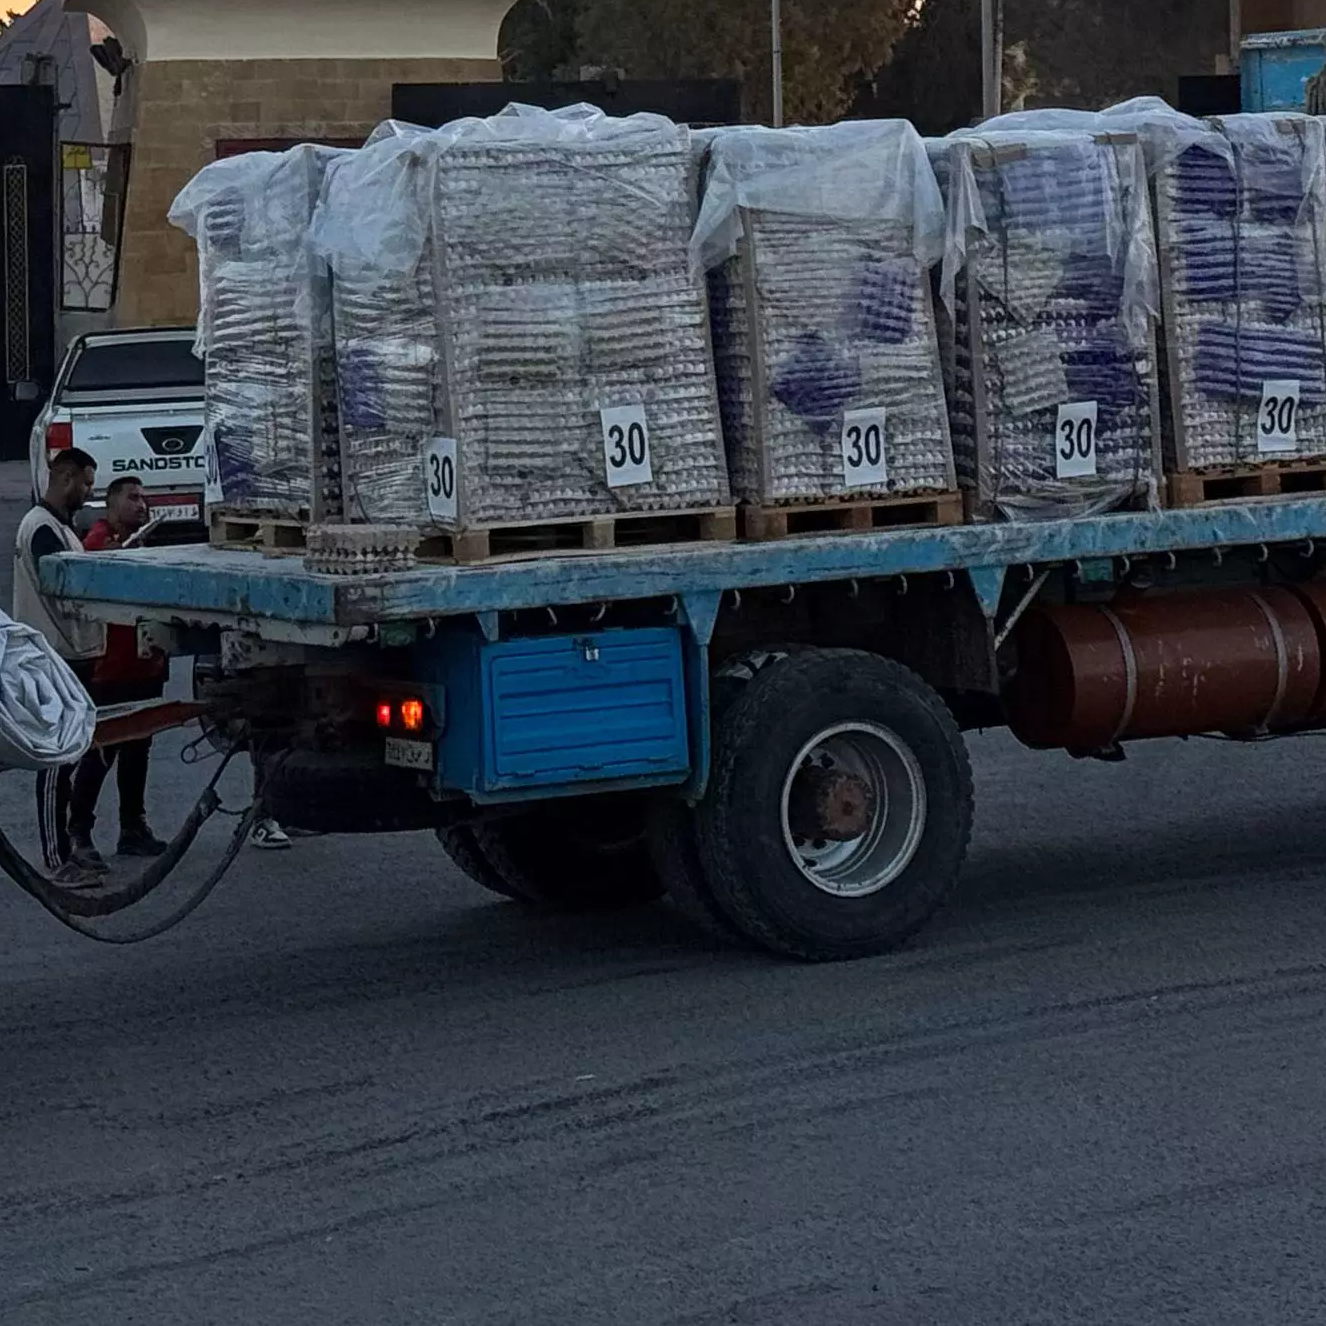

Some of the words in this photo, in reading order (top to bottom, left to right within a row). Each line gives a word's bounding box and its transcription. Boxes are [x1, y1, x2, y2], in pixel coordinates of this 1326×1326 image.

[1260, 396, 1295, 435] 30
[608, 421, 646, 469] 30
[846, 424, 881, 468] 30
[1060, 417, 1093, 461] 30
[112, 455, 205, 472] SANDSTO
[429, 453, 454, 500] 30
